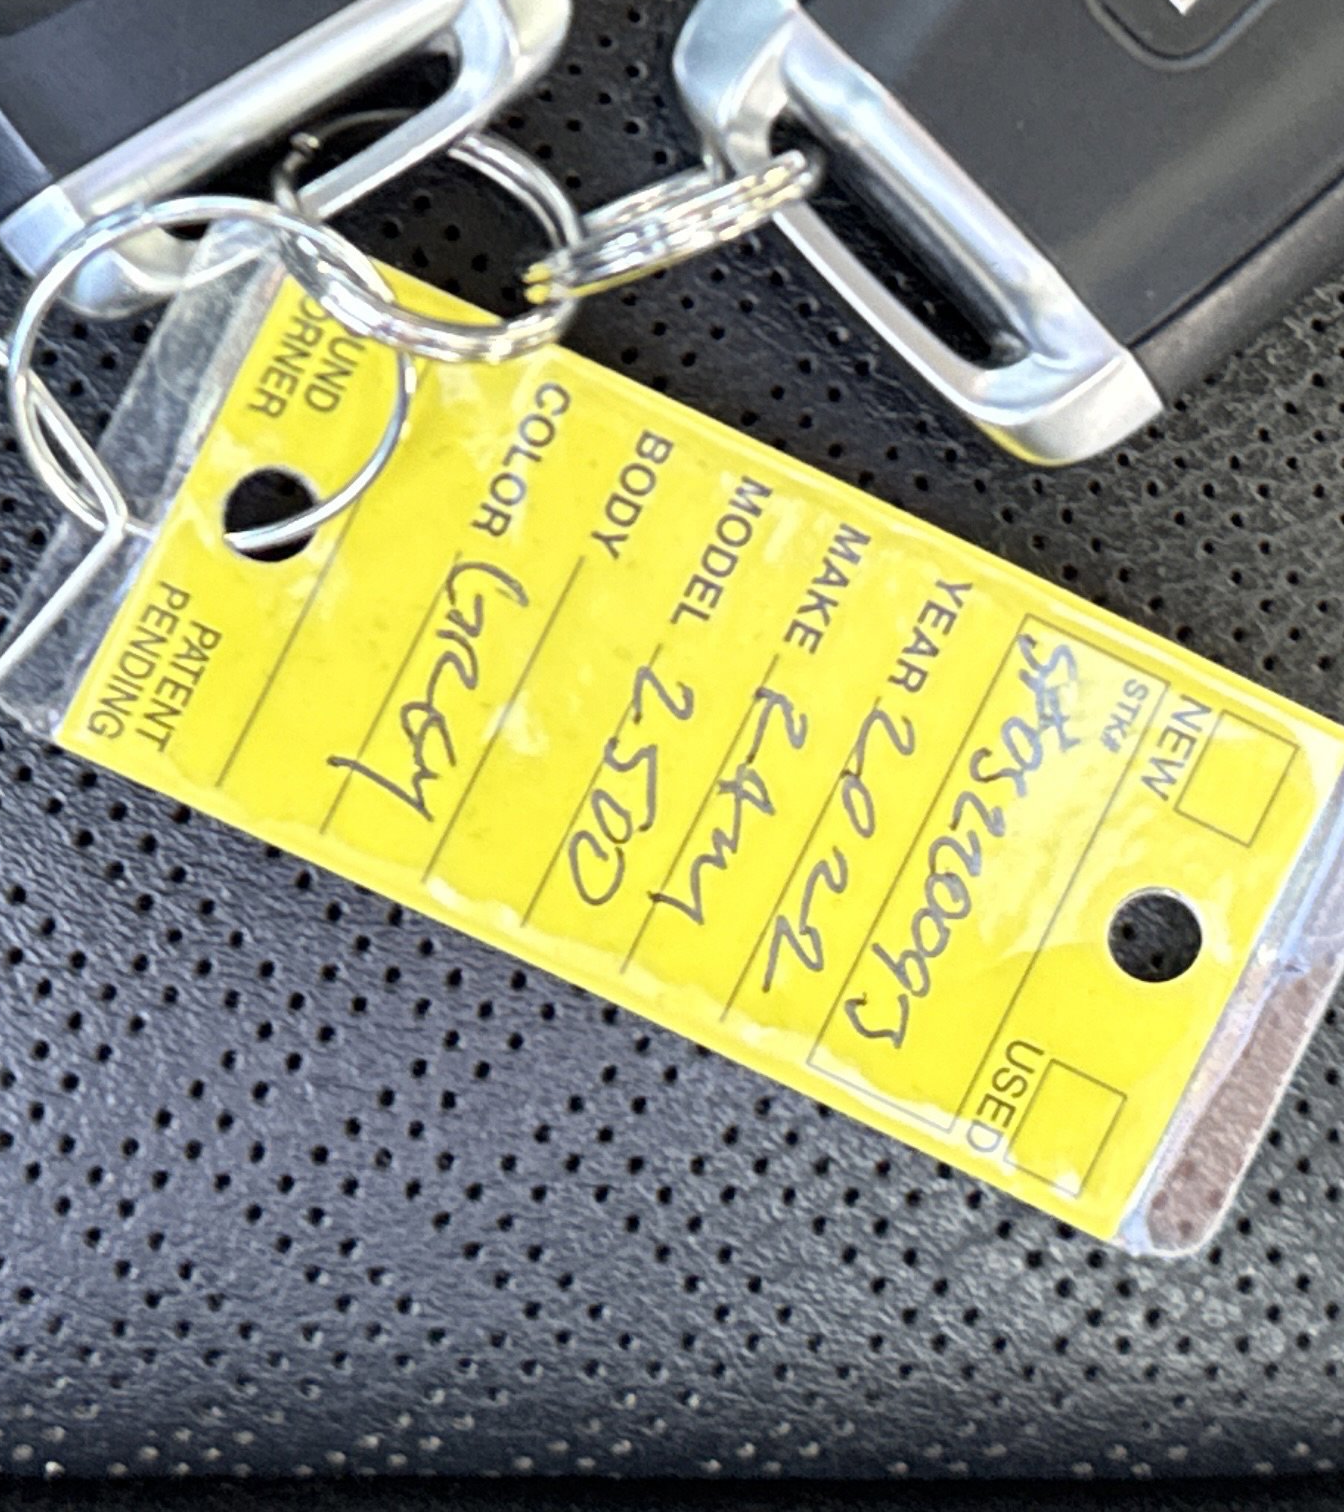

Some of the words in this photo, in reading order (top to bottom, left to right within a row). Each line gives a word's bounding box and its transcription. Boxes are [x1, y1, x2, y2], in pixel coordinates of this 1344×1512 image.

[246, 299, 331, 420] ORNER
[301, 330, 368, 414] UND
[470, 380, 573, 538] COLOR
[591, 428, 675, 561] BODY
[669, 473, 775, 626] MODEL
[782, 521, 873, 655] MAKE
[86, 579, 192, 742] PENDING
[135, 619, 224, 754] PATENT
[886, 576, 974, 694] YEAR
[1098, 676, 1150, 754] STK#
[1140, 692, 1213, 802] NEW
[567, 664, 695, 907] 2500
[759, 706, 917, 995] 2022
[964, 1037, 1046, 1154] USED
